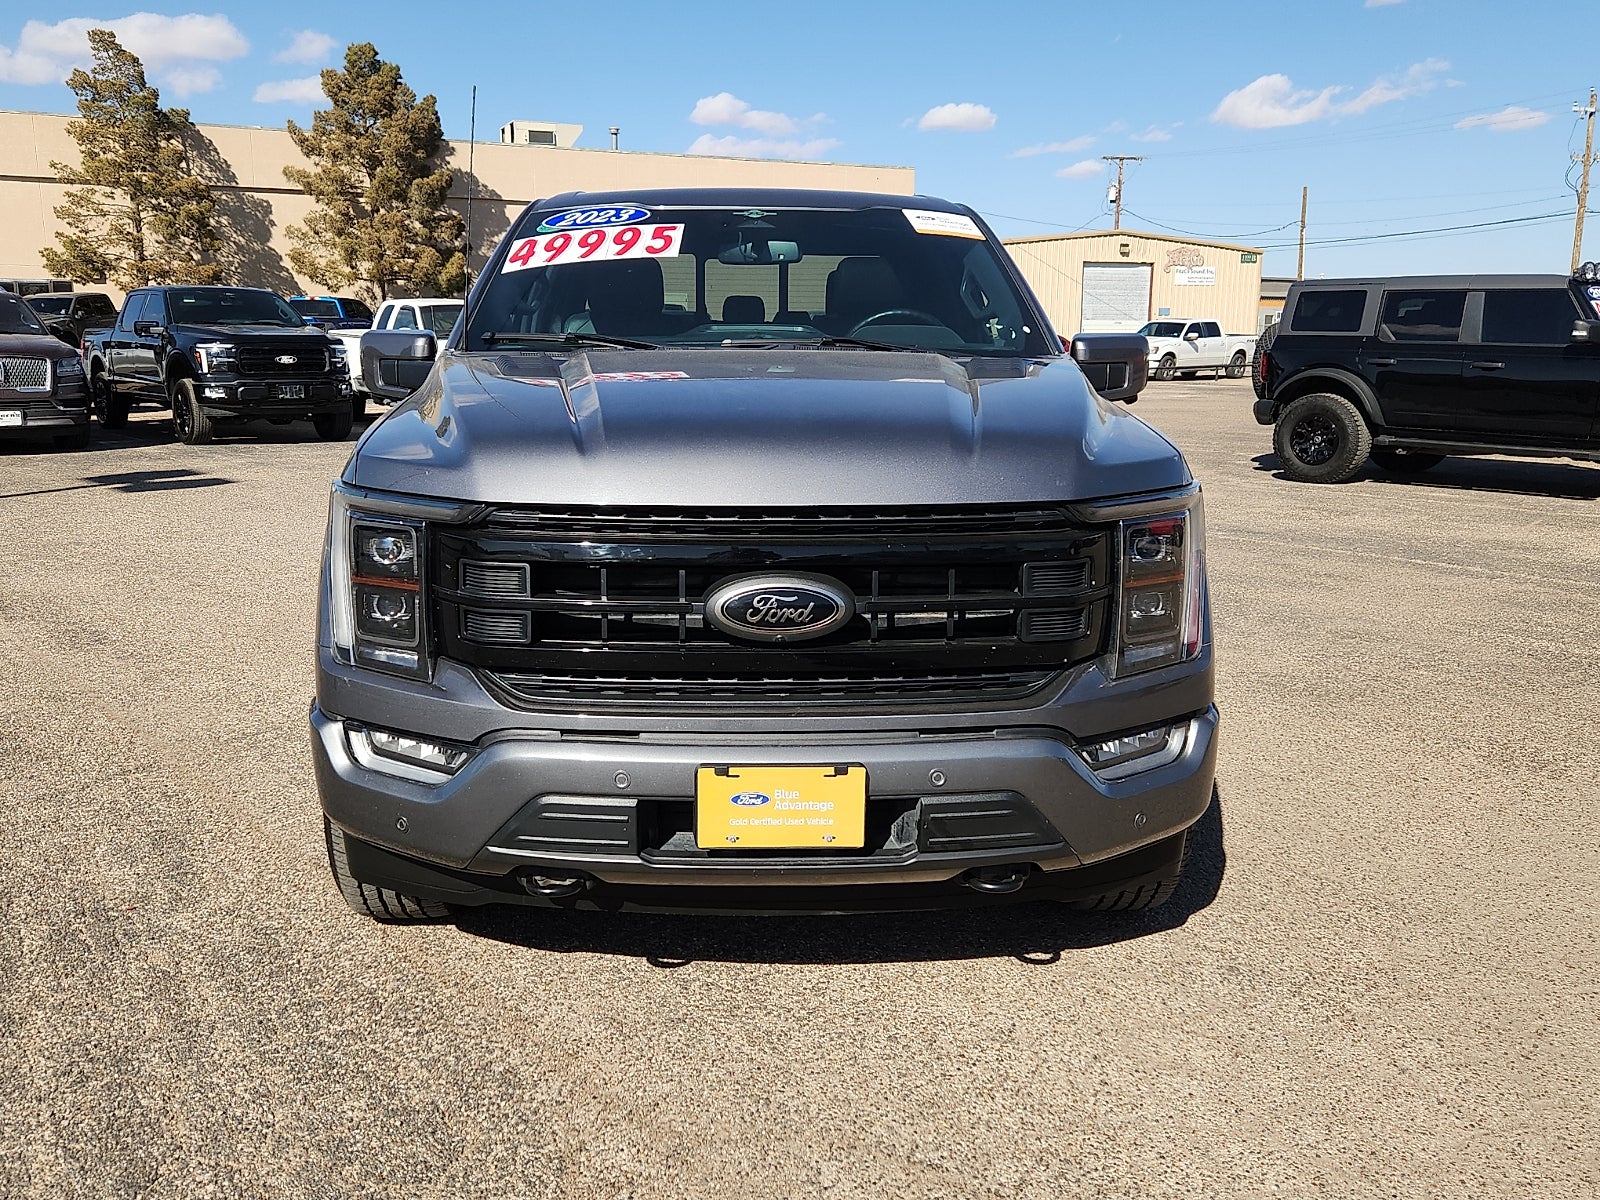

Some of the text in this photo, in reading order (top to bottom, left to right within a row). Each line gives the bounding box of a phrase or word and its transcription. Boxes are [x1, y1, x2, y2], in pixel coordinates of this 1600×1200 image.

[556, 209, 635, 226] 2023
[508, 225, 679, 267] 49995
[746, 594, 815, 623] Ford
[737, 794, 763, 805] Ford
[774, 789, 799, 799] Blue
[774, 800, 834, 812] Advantage
[729, 817, 834, 826] Gold Certified Used Vehicle
